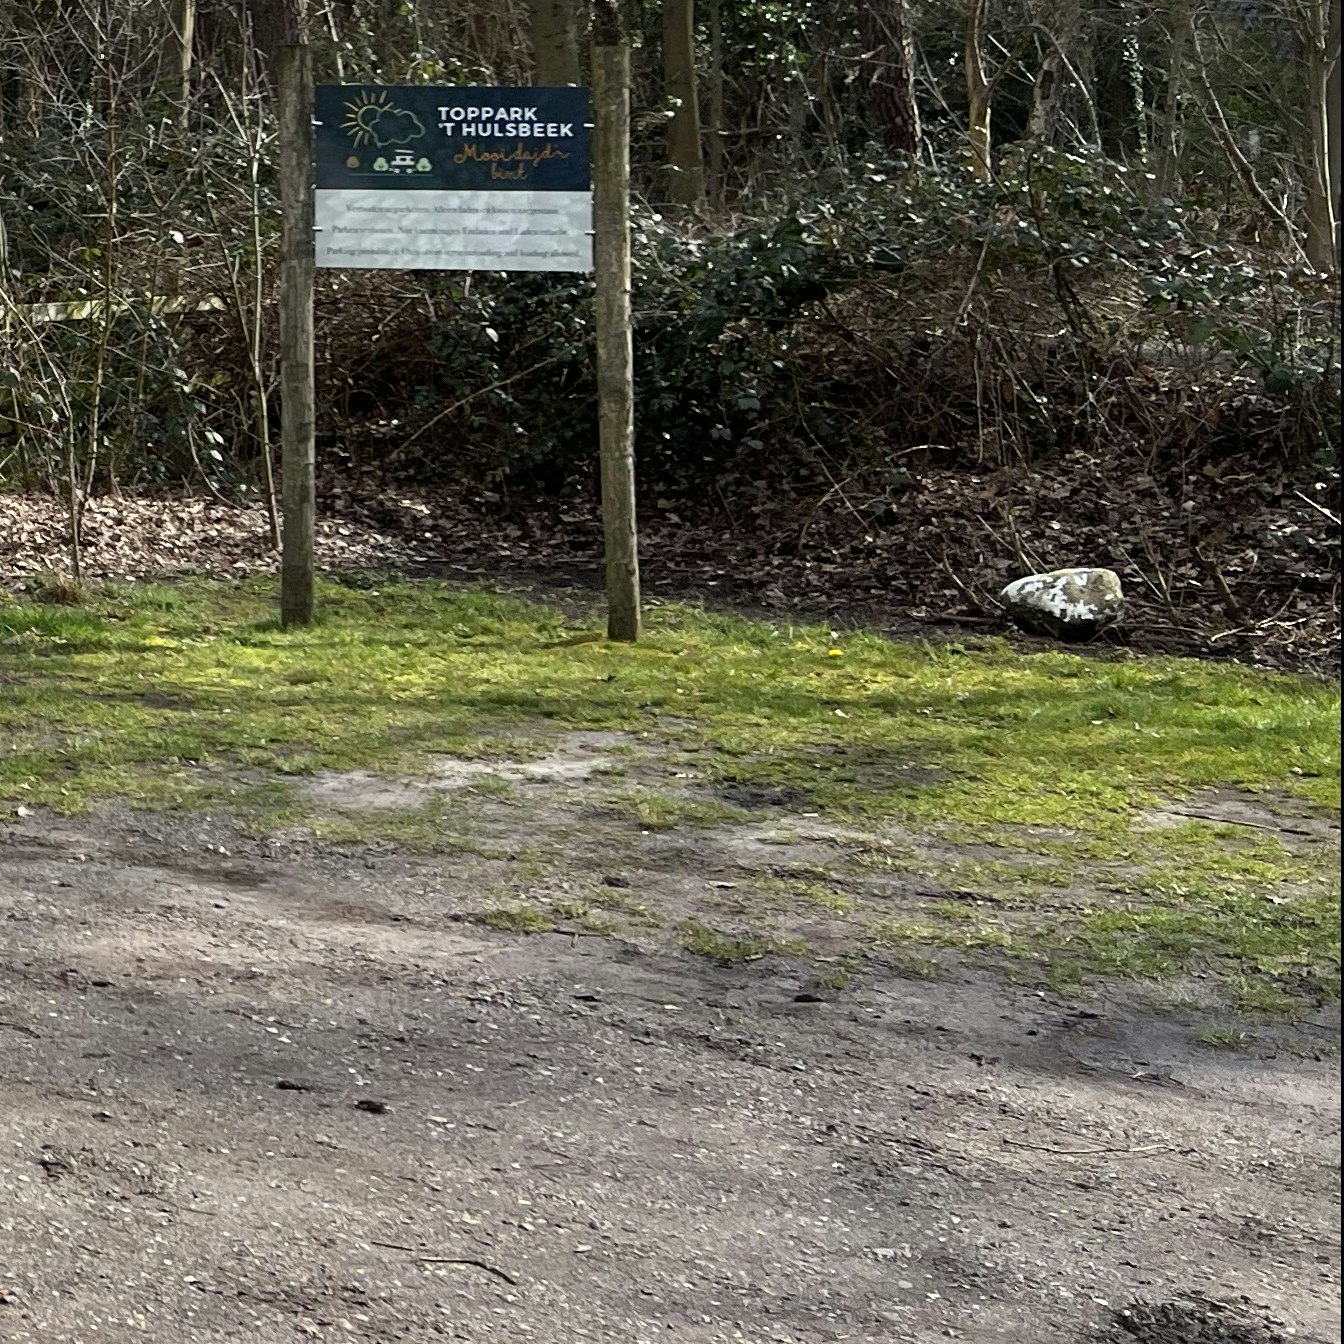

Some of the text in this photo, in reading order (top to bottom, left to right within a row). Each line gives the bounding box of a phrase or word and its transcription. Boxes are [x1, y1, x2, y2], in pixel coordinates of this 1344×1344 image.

[438, 106, 538, 121] TOPPARK
[438, 123, 574, 137] 'T HULSBEEK
